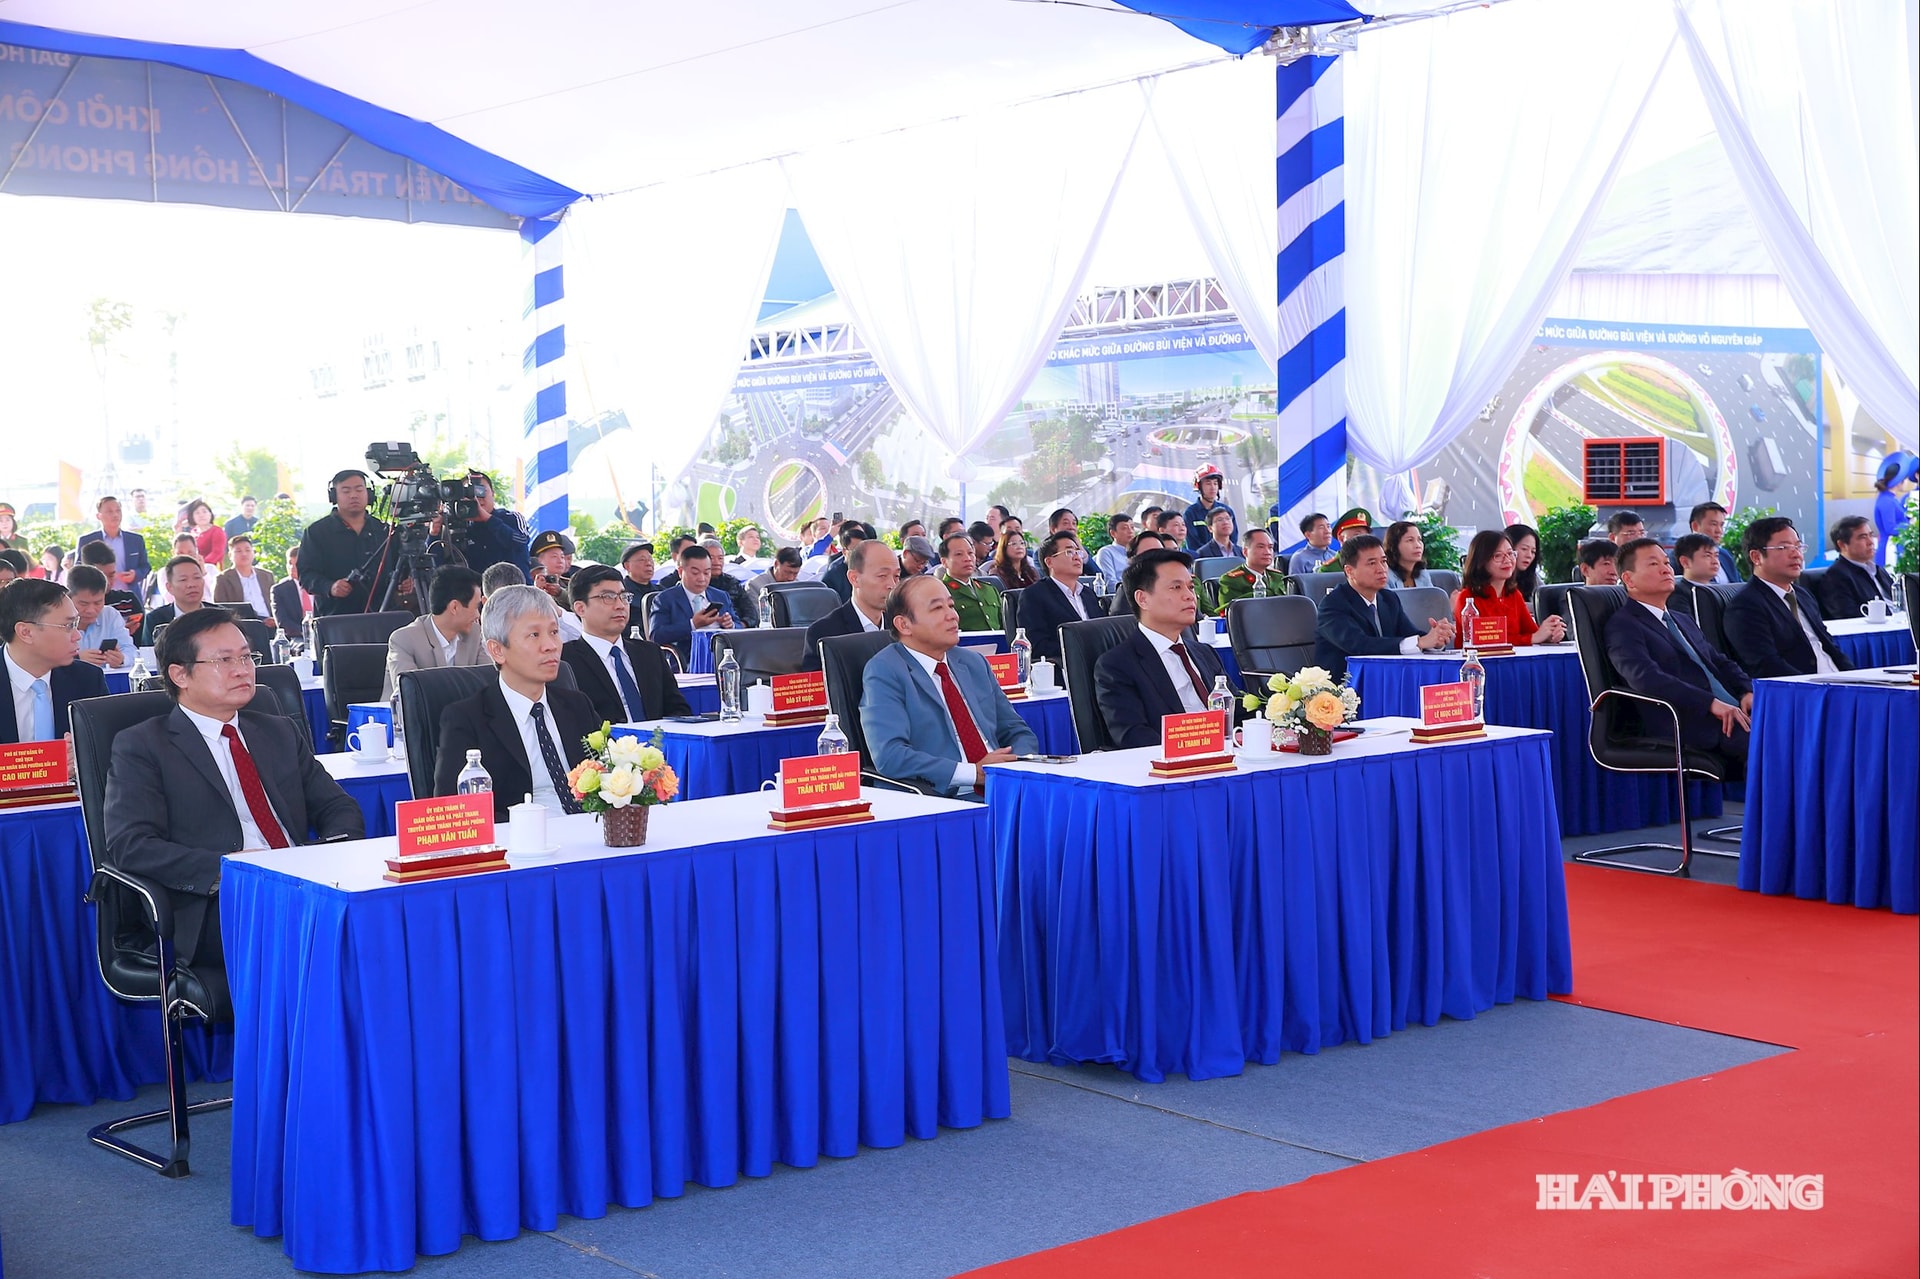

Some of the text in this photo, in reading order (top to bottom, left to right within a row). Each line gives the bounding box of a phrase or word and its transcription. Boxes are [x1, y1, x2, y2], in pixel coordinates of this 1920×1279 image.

[1566, 326, 1587, 340] GIỮA
[1588, 328, 1620, 341] ĐƯỜNG
[1620, 329, 1634, 342] BÙI
[1636, 330, 1654, 345] VIỆN
[1656, 330, 1668, 343] VÀ
[1668, 331, 1697, 344] ĐƯỜNG
[1698, 332, 1710, 345] VÕ
[1711, 333, 1743, 346] NGUYÊN
[1744, 333, 1763, 346] GIÁP
[1058, 346, 1081, 360] KHÁC
[1082, 344, 1101, 357] MỨC
[1102, 343, 1121, 356] GIỮA
[1124, 339, 1154, 354] ĐƯỜNG
[1156, 336, 1171, 350] BÙI
[1172, 336, 1193, 351] VIỆN
[1194, 334, 1207, 347] VÀ
[1208, 332, 1242, 346] ĐƯỜNG
[802, 371, 818, 385] VIỆN
[828, 368, 852, 380] ĐƯỜNG
[1201, 737, 1210, 746] TÂN
[32, 769, 48, 778] HIẾU
[814, 783, 827, 794] VIỆT
[828, 780, 844, 791] TUẤN
[417, 827, 477, 846] PHẠM VĂN TUẤN
